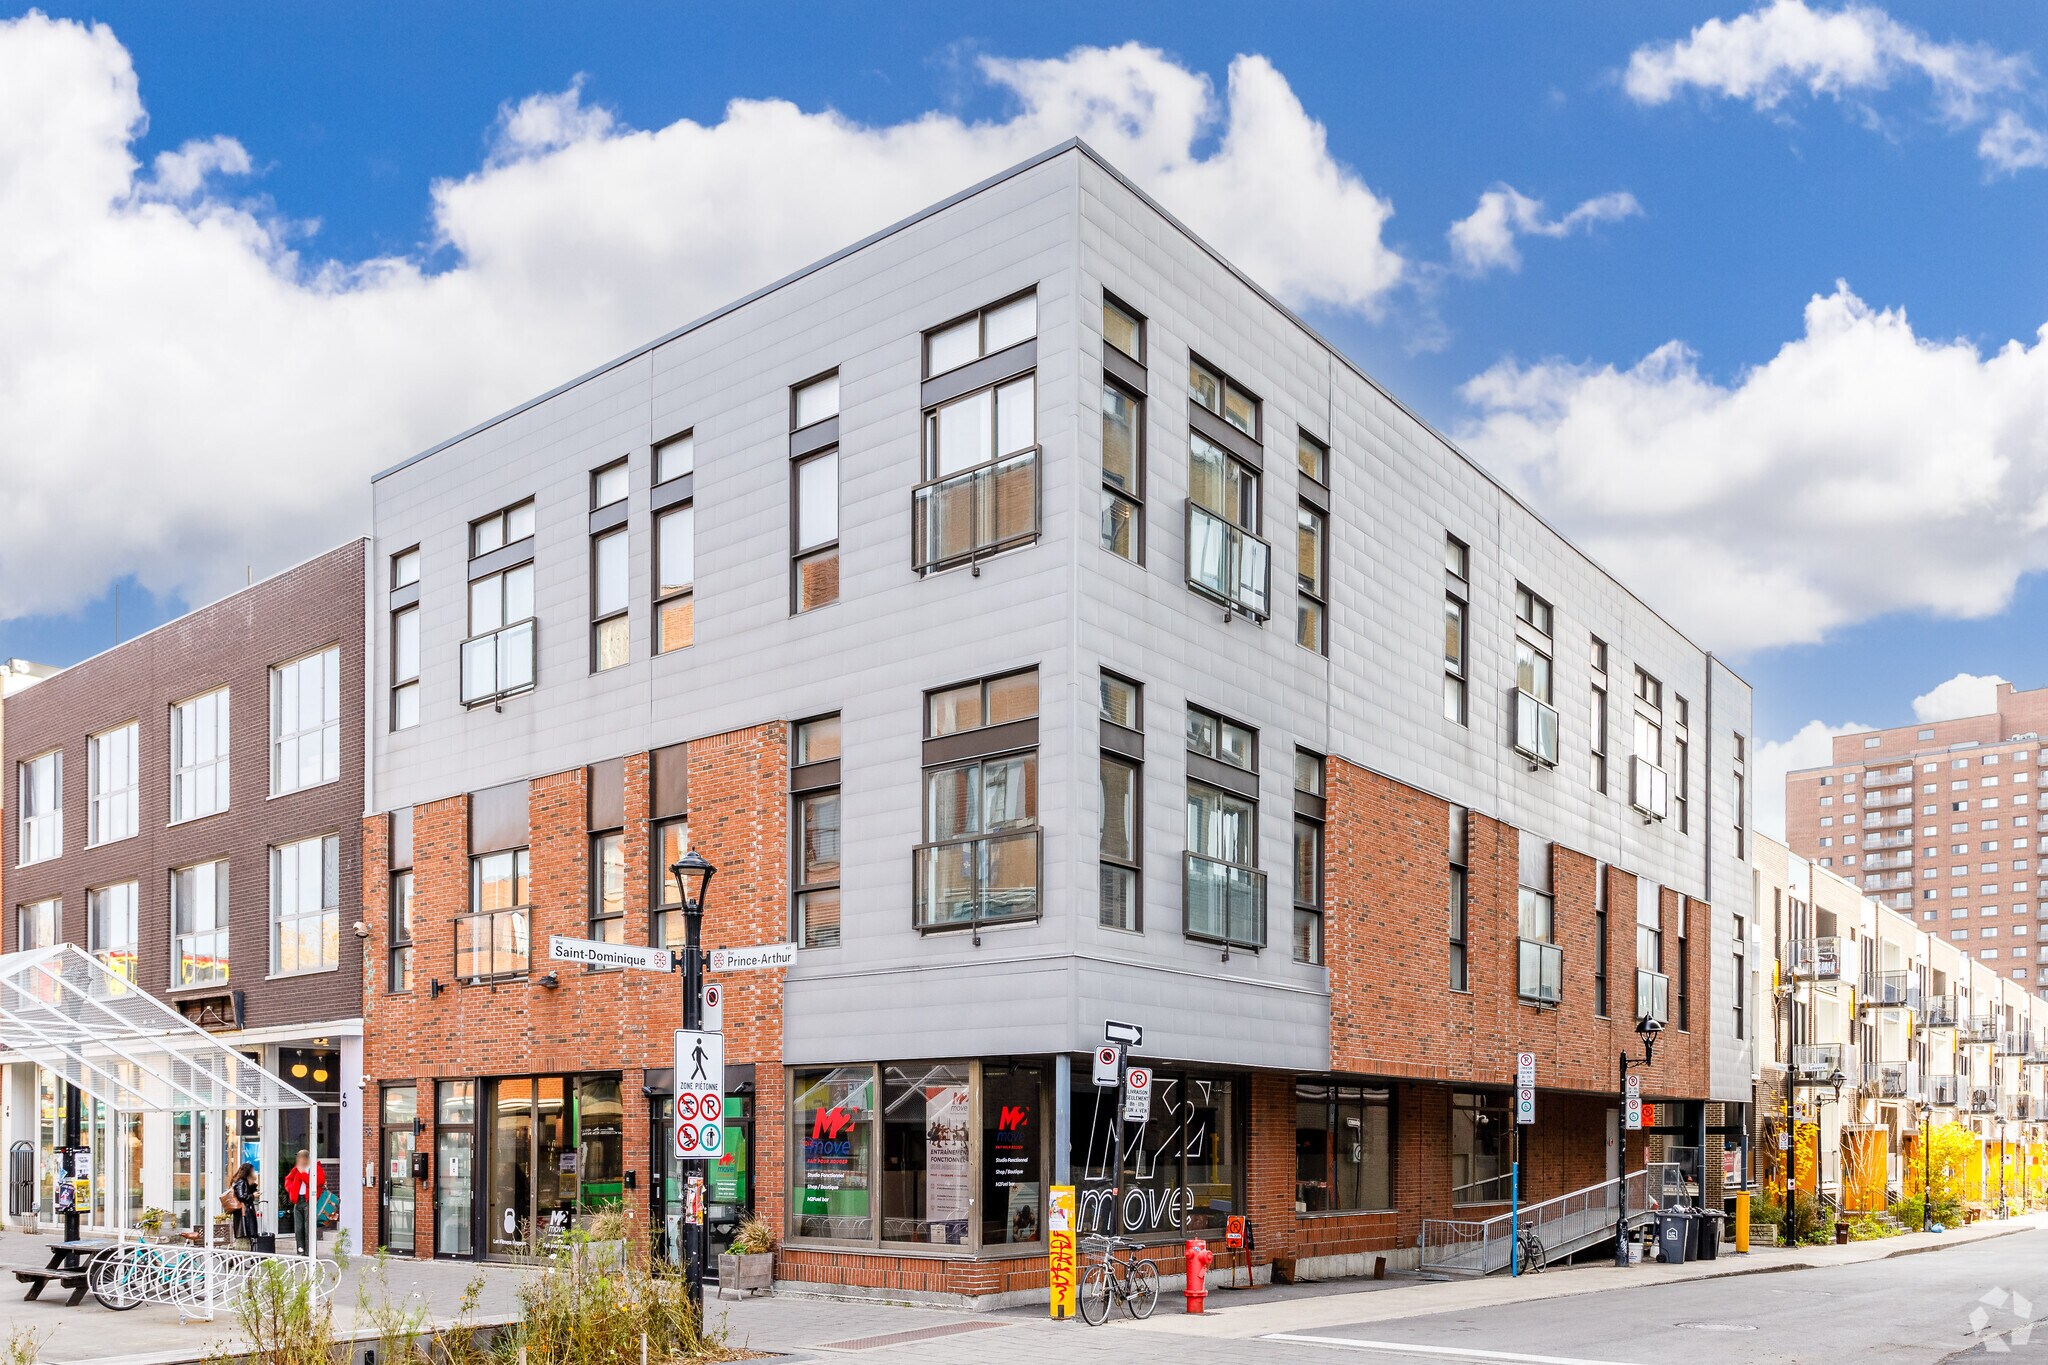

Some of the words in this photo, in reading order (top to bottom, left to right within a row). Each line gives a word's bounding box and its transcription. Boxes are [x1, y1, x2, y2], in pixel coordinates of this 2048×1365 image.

[555, 945, 646, 967] Saint-Dominique
[727, 952, 792, 967] Prince-Arthur
[680, 1082, 693, 1090] ZONE
[695, 1081, 718, 1091] PIÉTONNE
